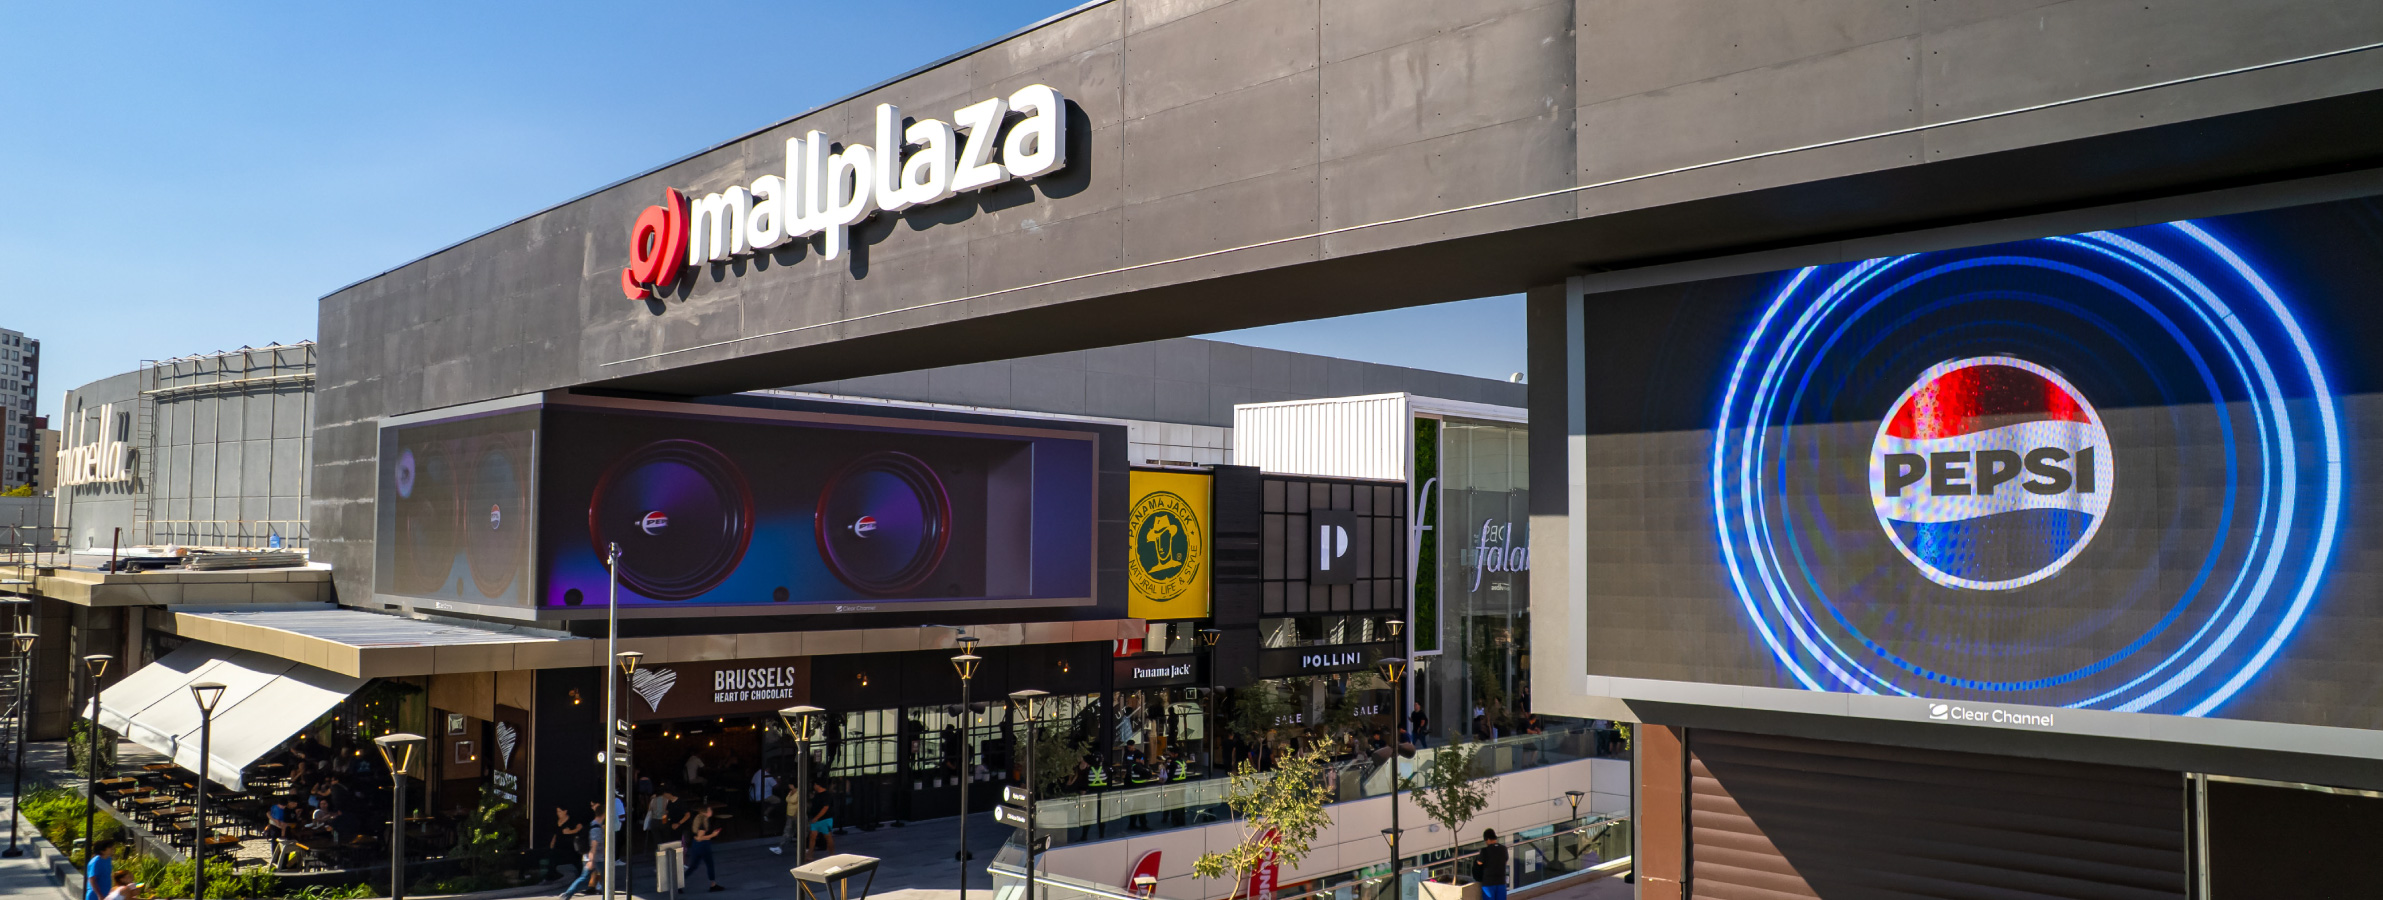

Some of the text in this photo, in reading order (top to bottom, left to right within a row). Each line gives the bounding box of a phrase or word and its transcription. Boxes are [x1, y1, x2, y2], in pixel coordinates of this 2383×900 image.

[689, 84, 1066, 261] mallplaza
[1884, 445, 2095, 497] PEPSI
[1129, 498, 1192, 537] PANAMA JACK
[1321, 525, 1348, 571] P
[1129, 559, 1157, 594] NATURAL
[1160, 582, 1176, 595] LIFE
[1184, 544, 1198, 575] STYLE
[1133, 663, 1190, 679] Panama Jack
[1302, 652, 1360, 668] POLLINI
[714, 666, 795, 691] BRUSSELS
[714, 688, 793, 703] HEART OF CHOCOLATE
[1275, 713, 1302, 726] SALE
[1353, 705, 1379, 717] SALE
[1951, 706, 2054, 727] Clear Channel
